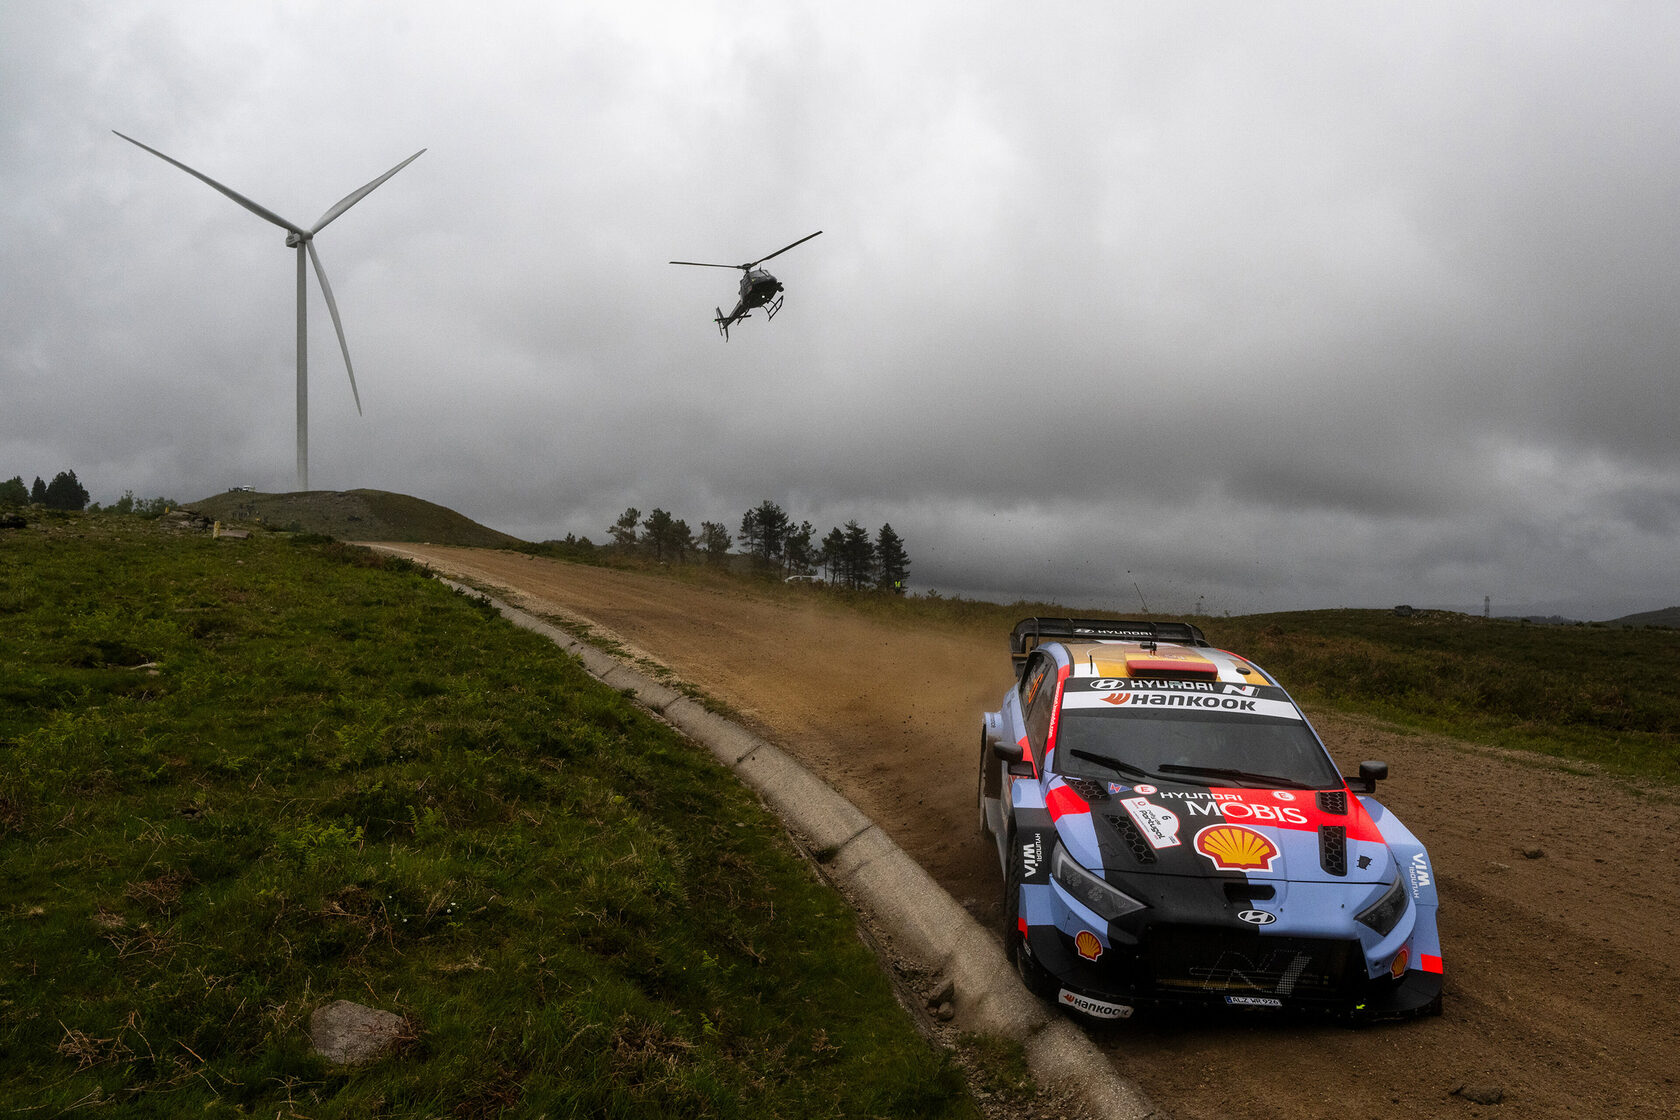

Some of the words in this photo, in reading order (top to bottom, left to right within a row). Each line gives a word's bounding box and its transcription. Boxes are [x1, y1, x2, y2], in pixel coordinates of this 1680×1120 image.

[1131, 679, 1214, 692] HYUNDAI
[1160, 791, 1243, 801] HYUNDAI
[1138, 809, 1166, 840] Portugal
[1185, 800, 1308, 824] MOBIS
[1034, 832, 1042, 862] HYUNDAI
[1409, 866, 1420, 899] HYUNDAI
